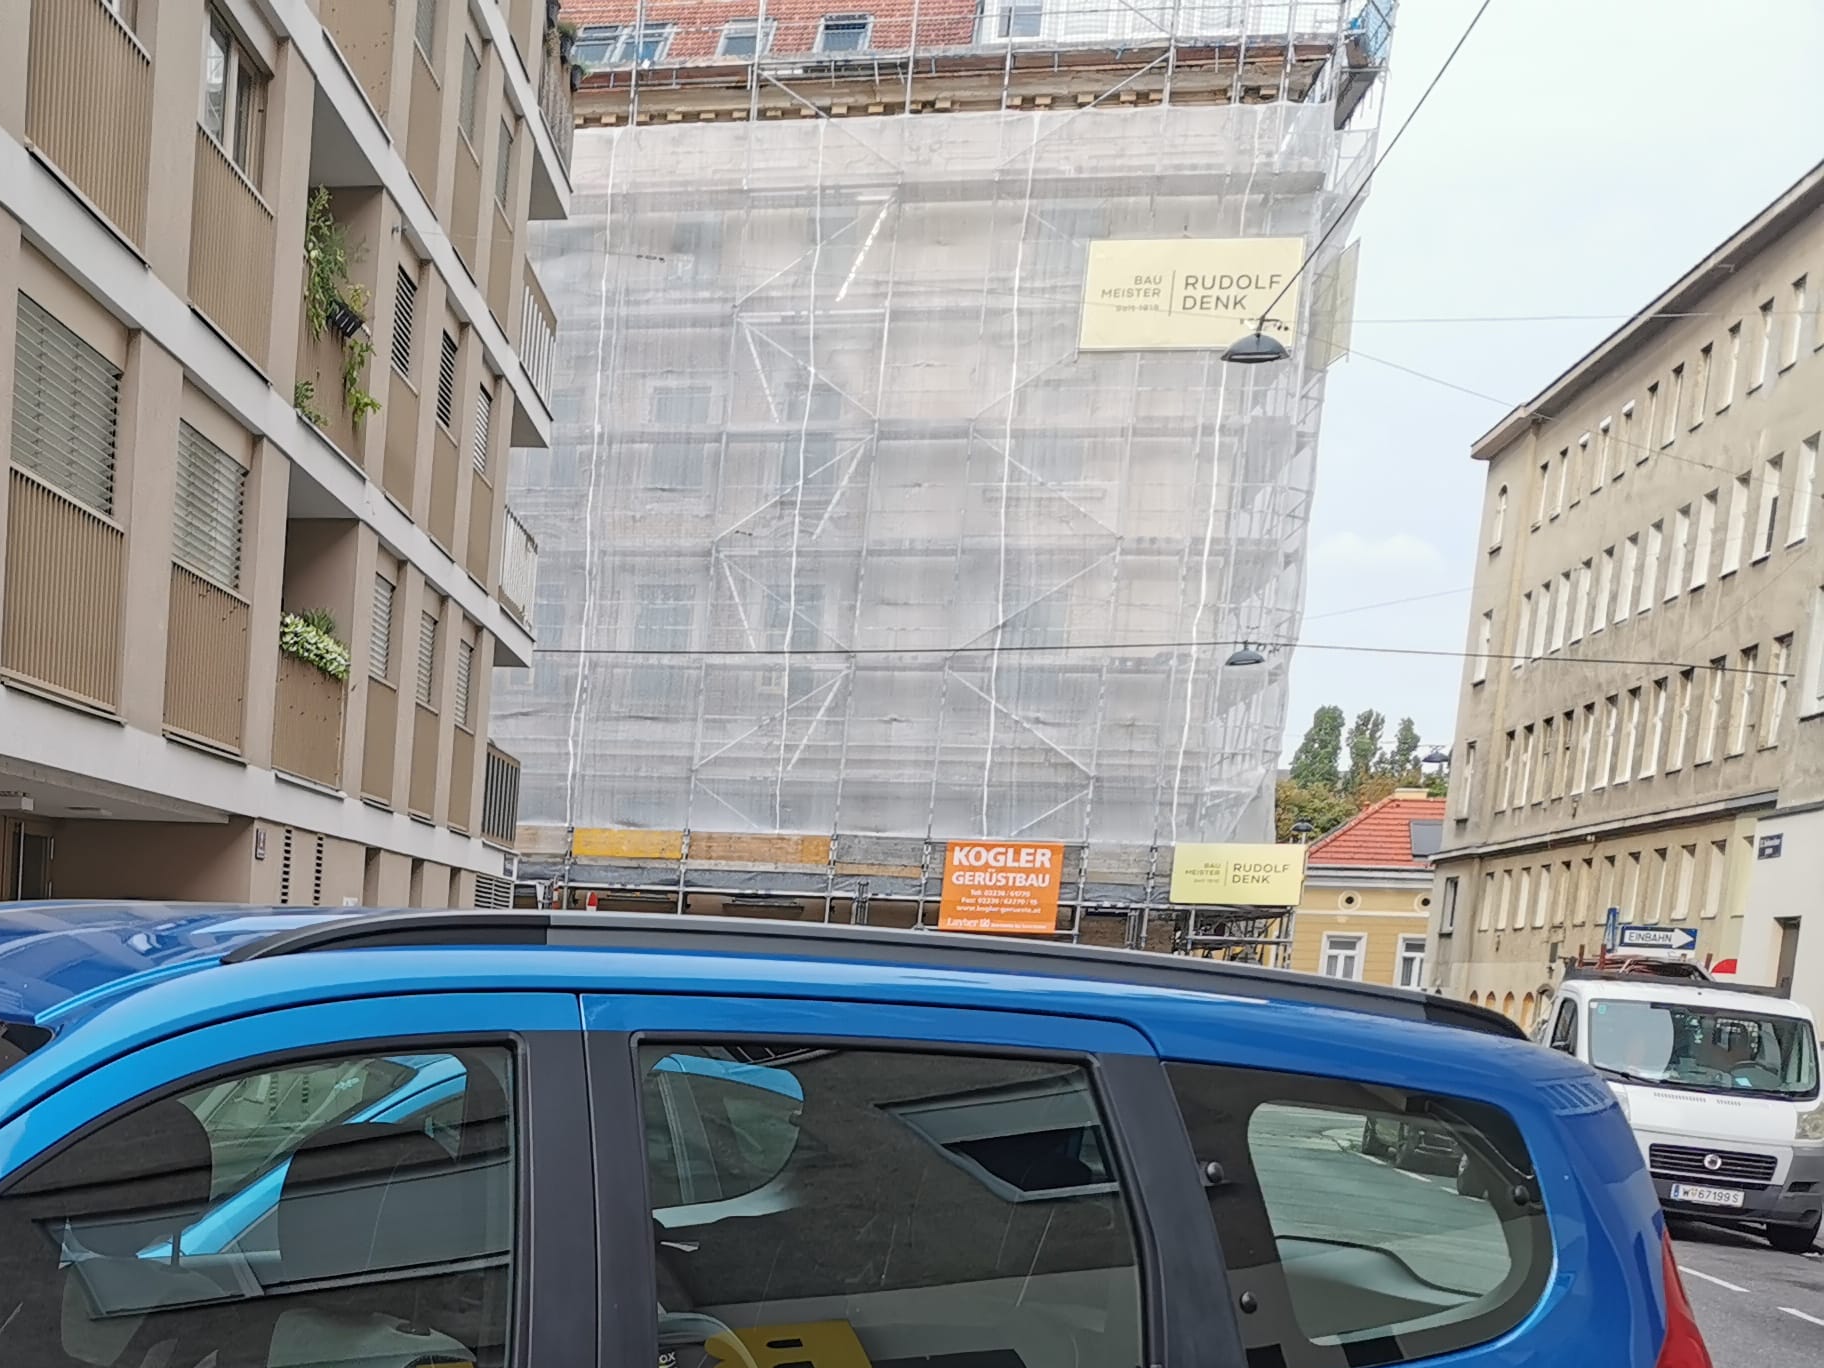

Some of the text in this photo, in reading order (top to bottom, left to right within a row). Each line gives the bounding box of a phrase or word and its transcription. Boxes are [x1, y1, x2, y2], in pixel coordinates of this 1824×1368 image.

[1134, 276, 1162, 286] BAU
[1184, 274, 1282, 291] RUDOLF
[1101, 288, 1161, 299] MEISTER
[1182, 295, 1248, 311] DENK
[953, 847, 1051, 867] KOGLER
[1233, 863, 1291, 874] RUDOLF
[952, 869, 1050, 887] GERÜSTBAU
[1231, 874, 1271, 884] DENK
[1628, 931, 1672, 944] EINBAHN
